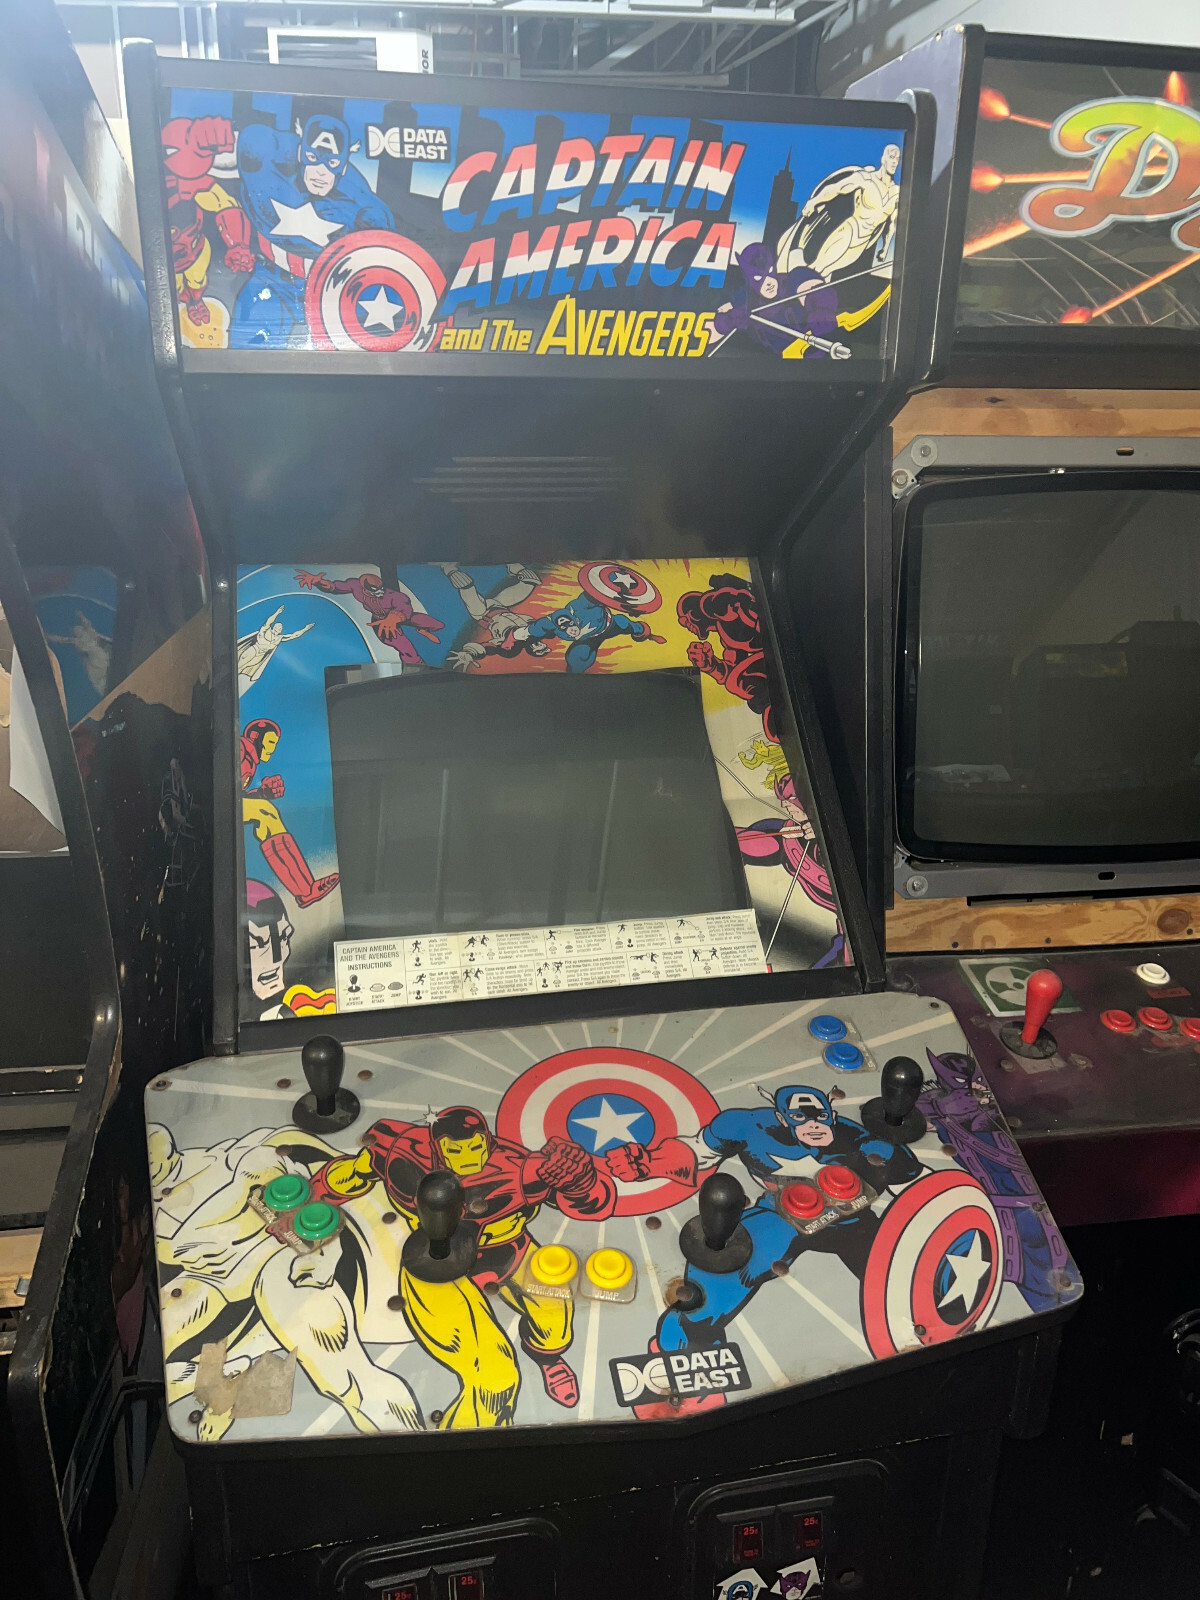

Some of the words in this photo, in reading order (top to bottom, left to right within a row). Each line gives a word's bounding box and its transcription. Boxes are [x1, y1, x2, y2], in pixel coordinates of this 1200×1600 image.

[403, 128, 447, 144] DATA
[404, 144, 448, 160] EAST
[441, 134, 745, 232] CAPTAIN
[438, 217, 738, 316] AMERICA
[440, 319, 488, 350] and
[490, 319, 532, 351] The
[342, 946, 368, 955] CAPTAIN
[369, 944, 397, 953] AMERICA
[355, 953, 367, 961] THE
[368, 951, 400, 960] AVENGERS
[347, 961, 393, 971] INSTRUCTIONS
[851, 1195, 869, 1210] JUMP
[283, 1231, 303, 1246] JUMP
[595, 1290, 620, 1300] JUMP
[669, 1348, 739, 1373] DATA
[674, 1367, 742, 1394] EAST
